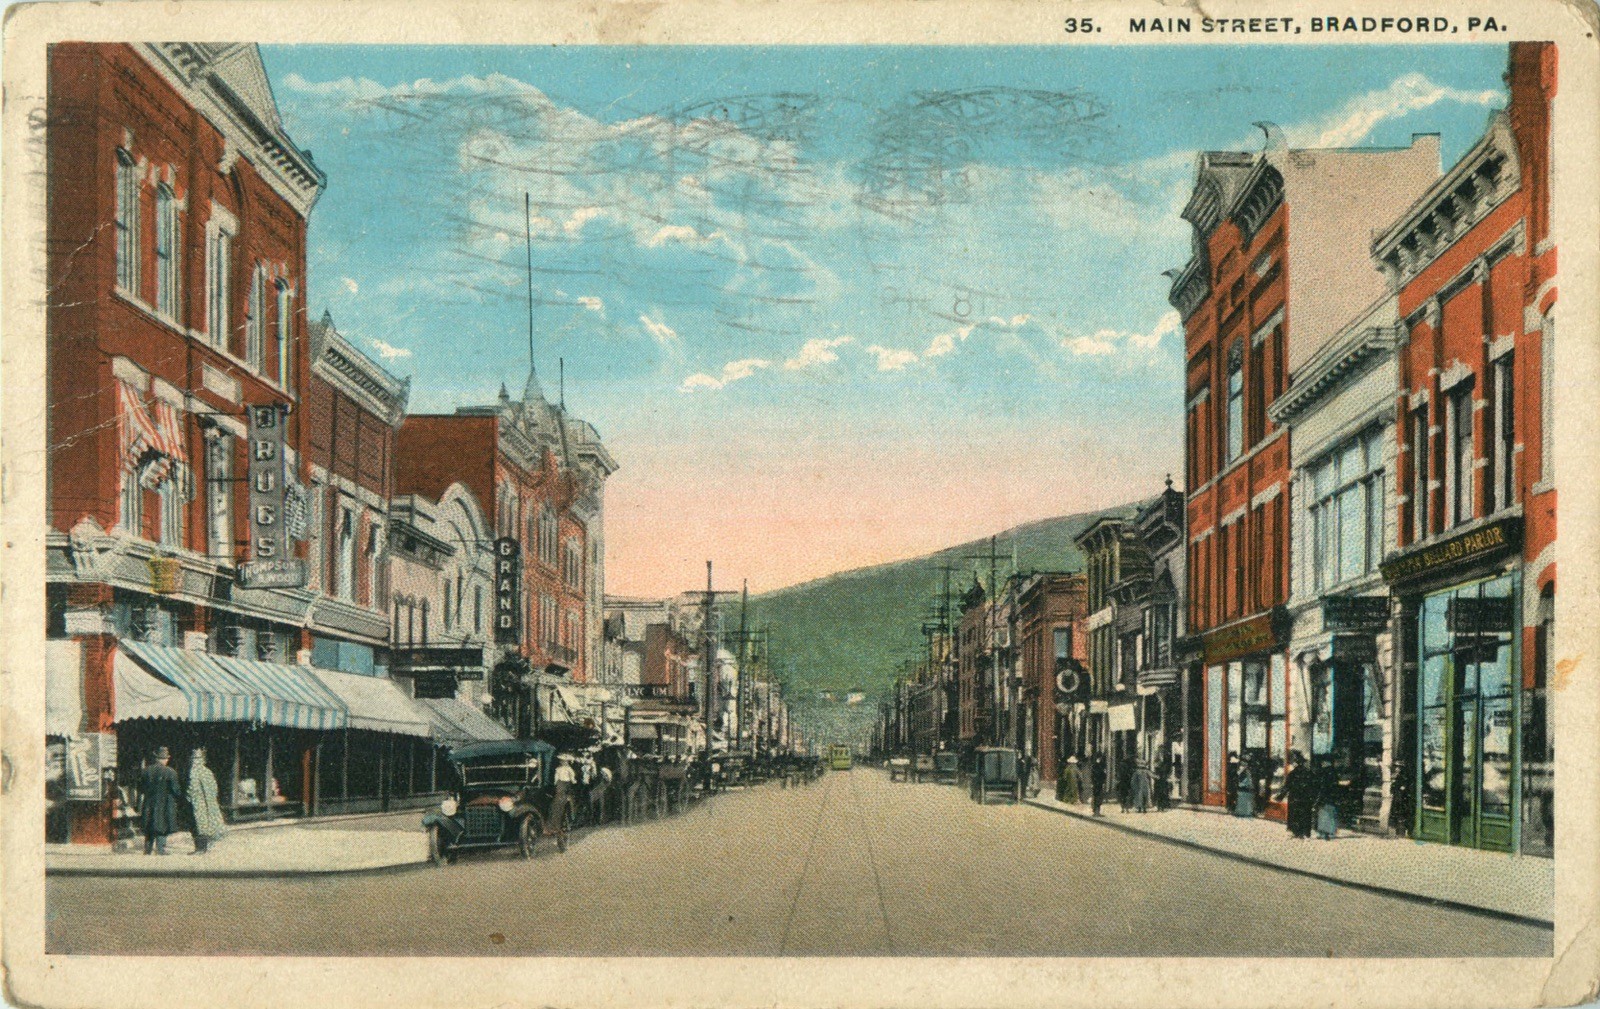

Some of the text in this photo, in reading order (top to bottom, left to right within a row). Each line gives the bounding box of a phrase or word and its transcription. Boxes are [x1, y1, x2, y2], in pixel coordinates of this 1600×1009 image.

[255, 406, 276, 557] DRUGS
[1464, 526, 1503, 554] PARLOR
[500, 542, 512, 628] GRAND
[627, 687, 667, 696] LYCUM
